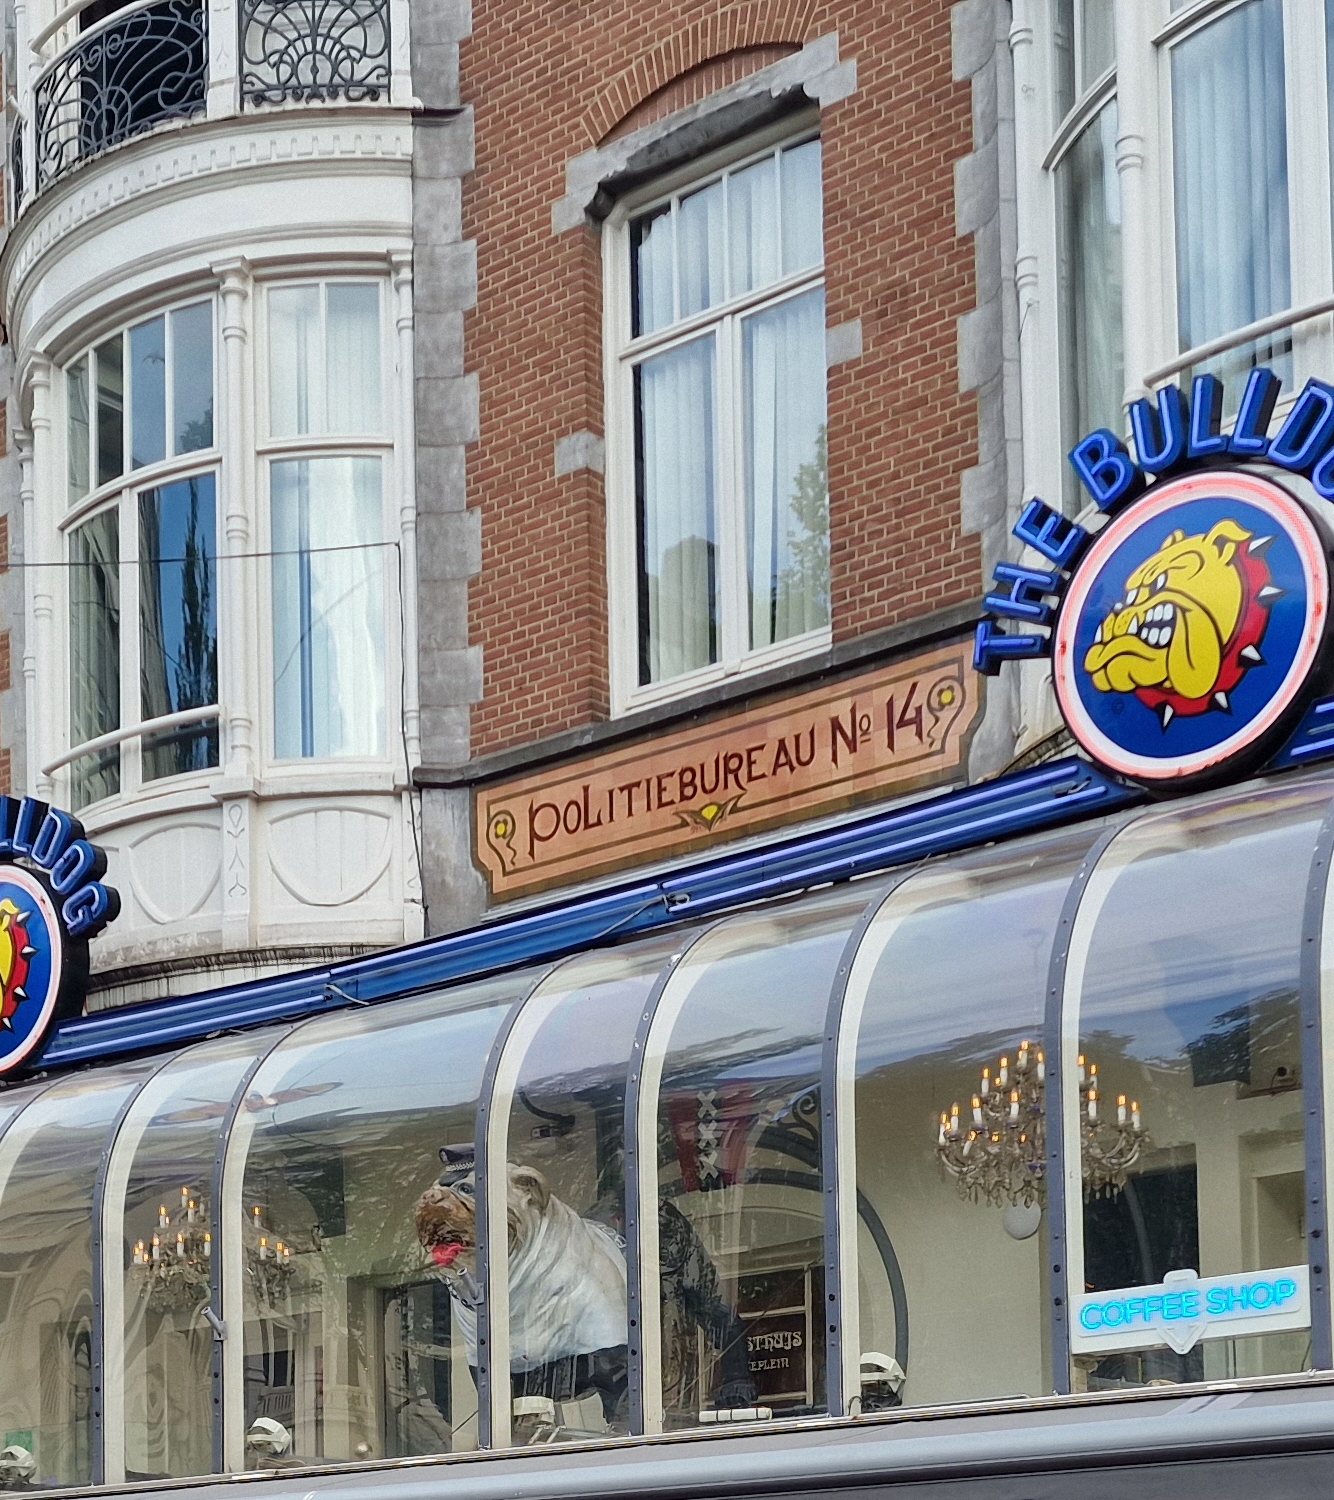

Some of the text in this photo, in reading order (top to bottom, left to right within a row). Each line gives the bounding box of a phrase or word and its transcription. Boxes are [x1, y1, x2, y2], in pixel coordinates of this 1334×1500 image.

[972, 496, 1089, 675] THE
[528, 724, 816, 859] POLITIEBUREAU
[886, 681, 924, 754] 14
[1080, 1279, 1296, 1330] COFFEE SHOP
